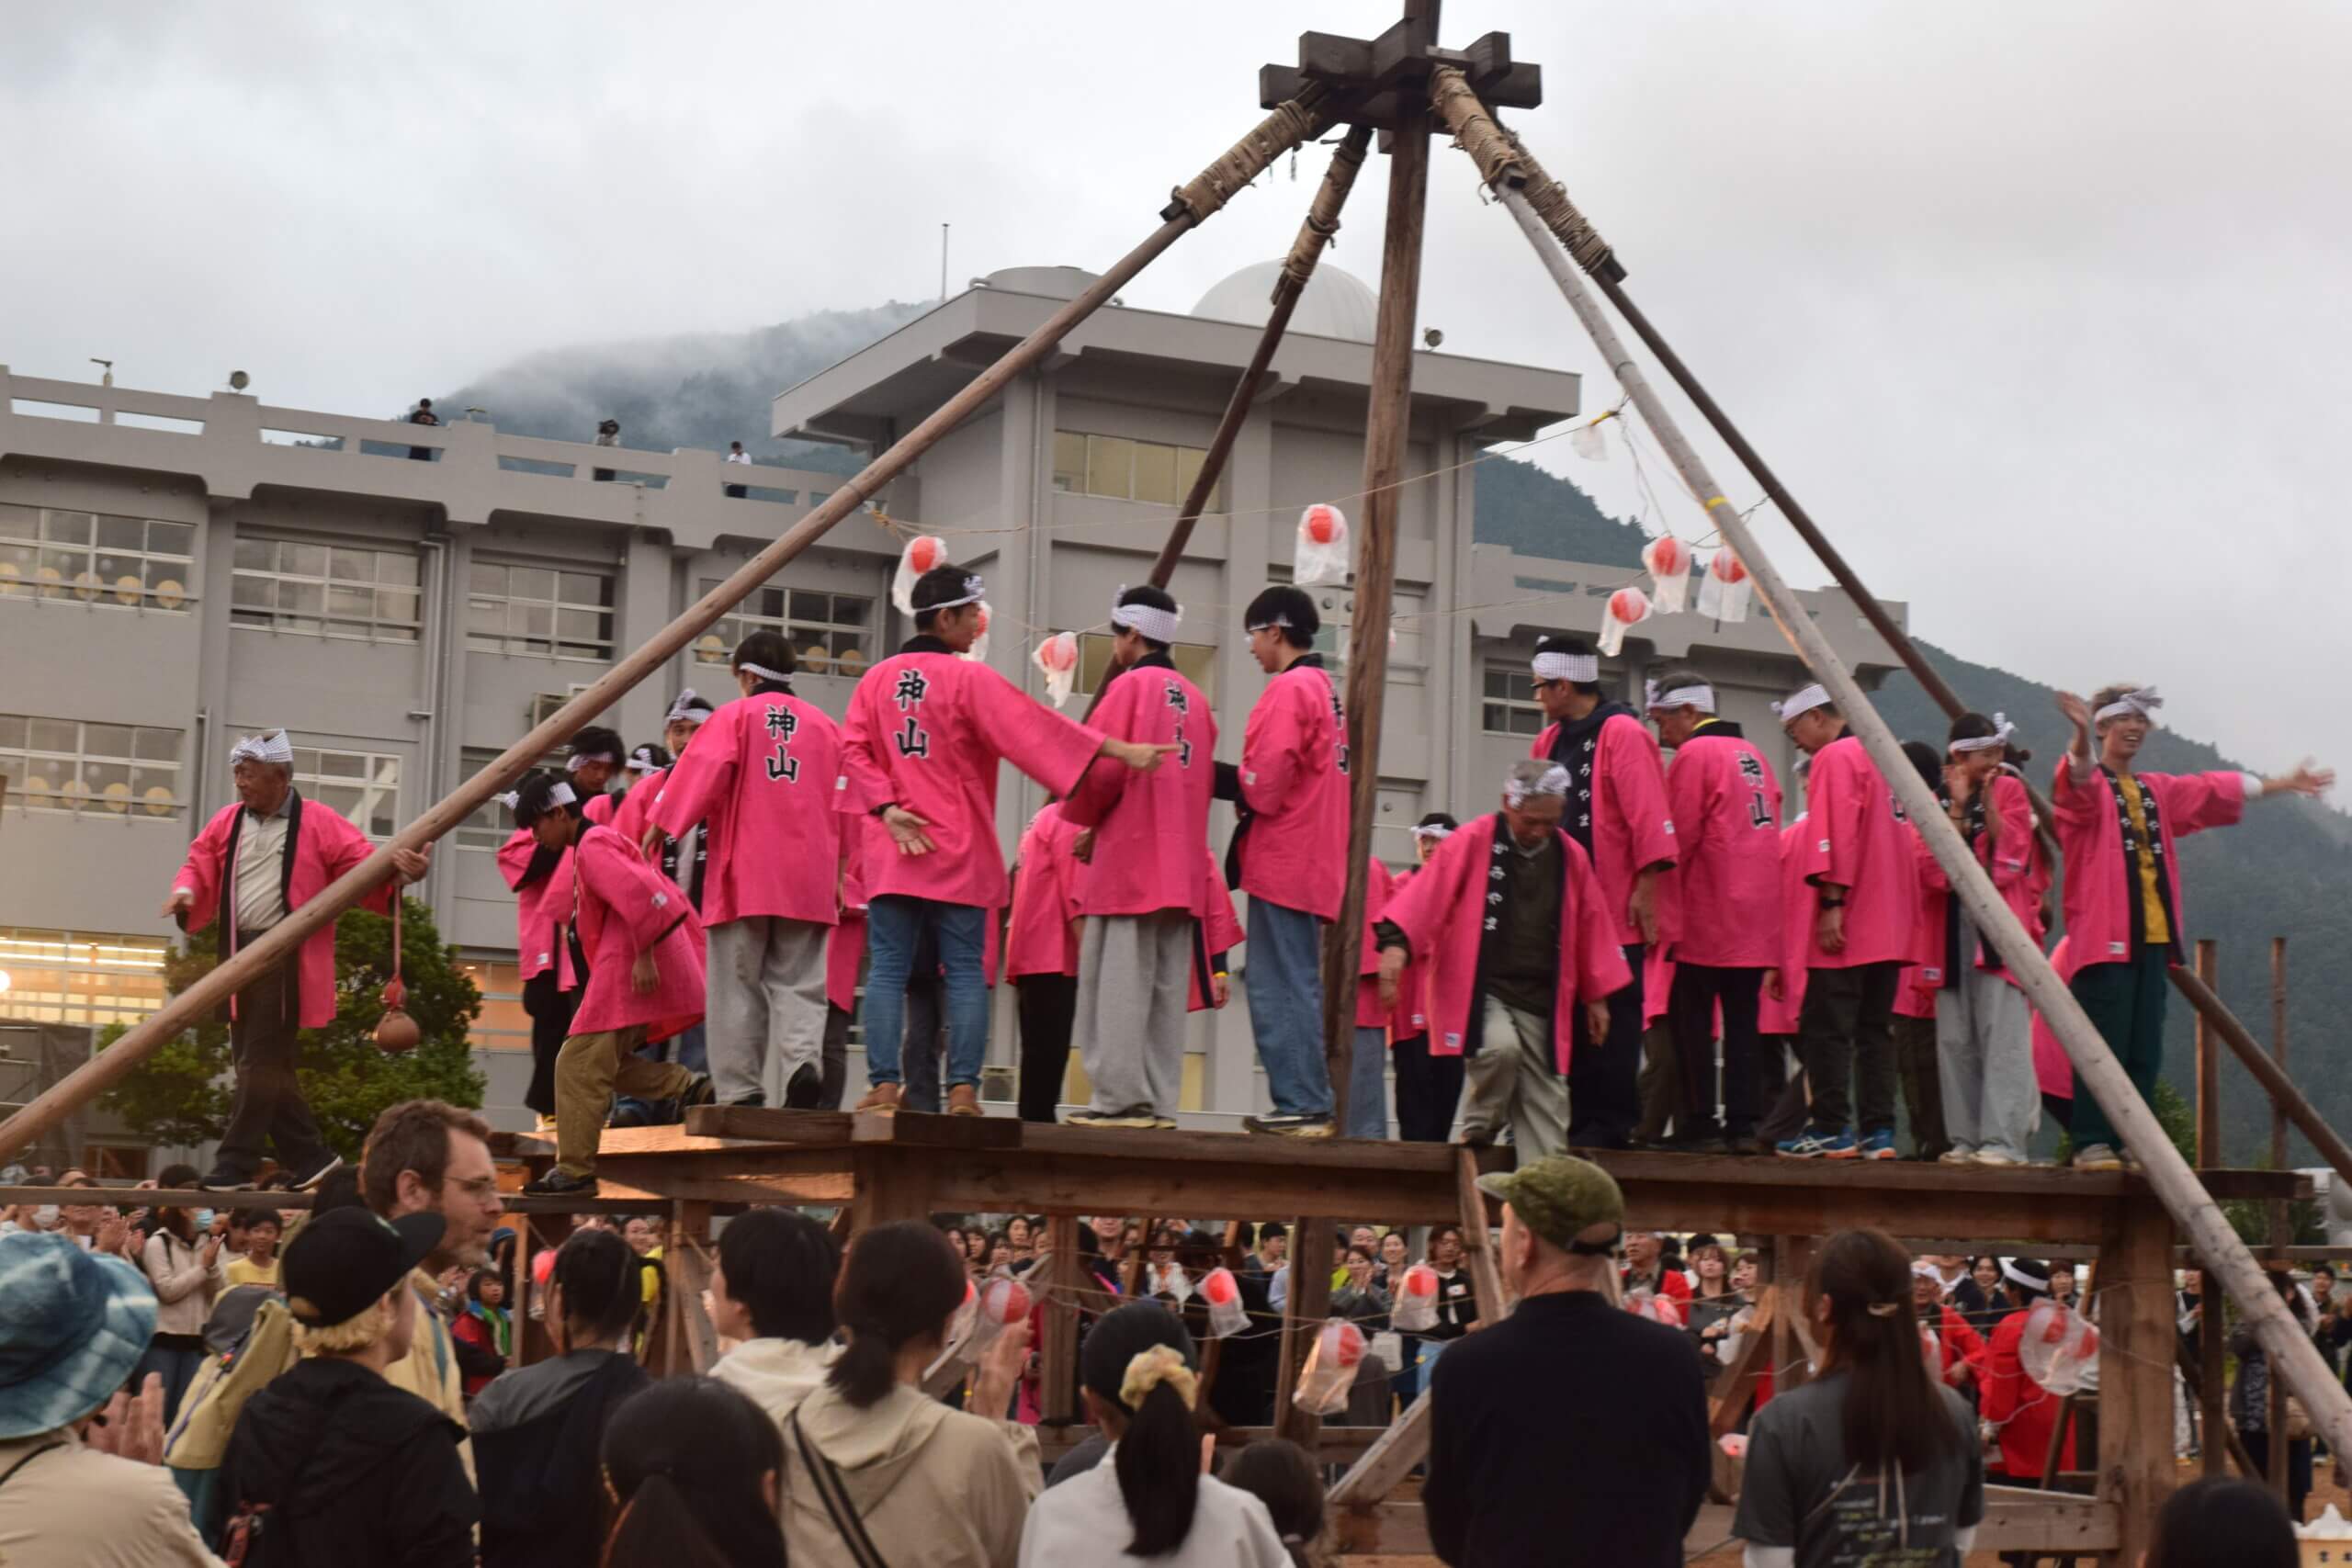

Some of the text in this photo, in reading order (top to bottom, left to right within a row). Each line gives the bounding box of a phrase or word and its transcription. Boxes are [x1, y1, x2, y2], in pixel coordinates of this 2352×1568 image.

[764, 704, 800, 784] 神山
[893, 670, 929, 759] 神山
[1579, 739, 1596, 827] かみやま
[1484, 841, 1509, 931] かみやま
